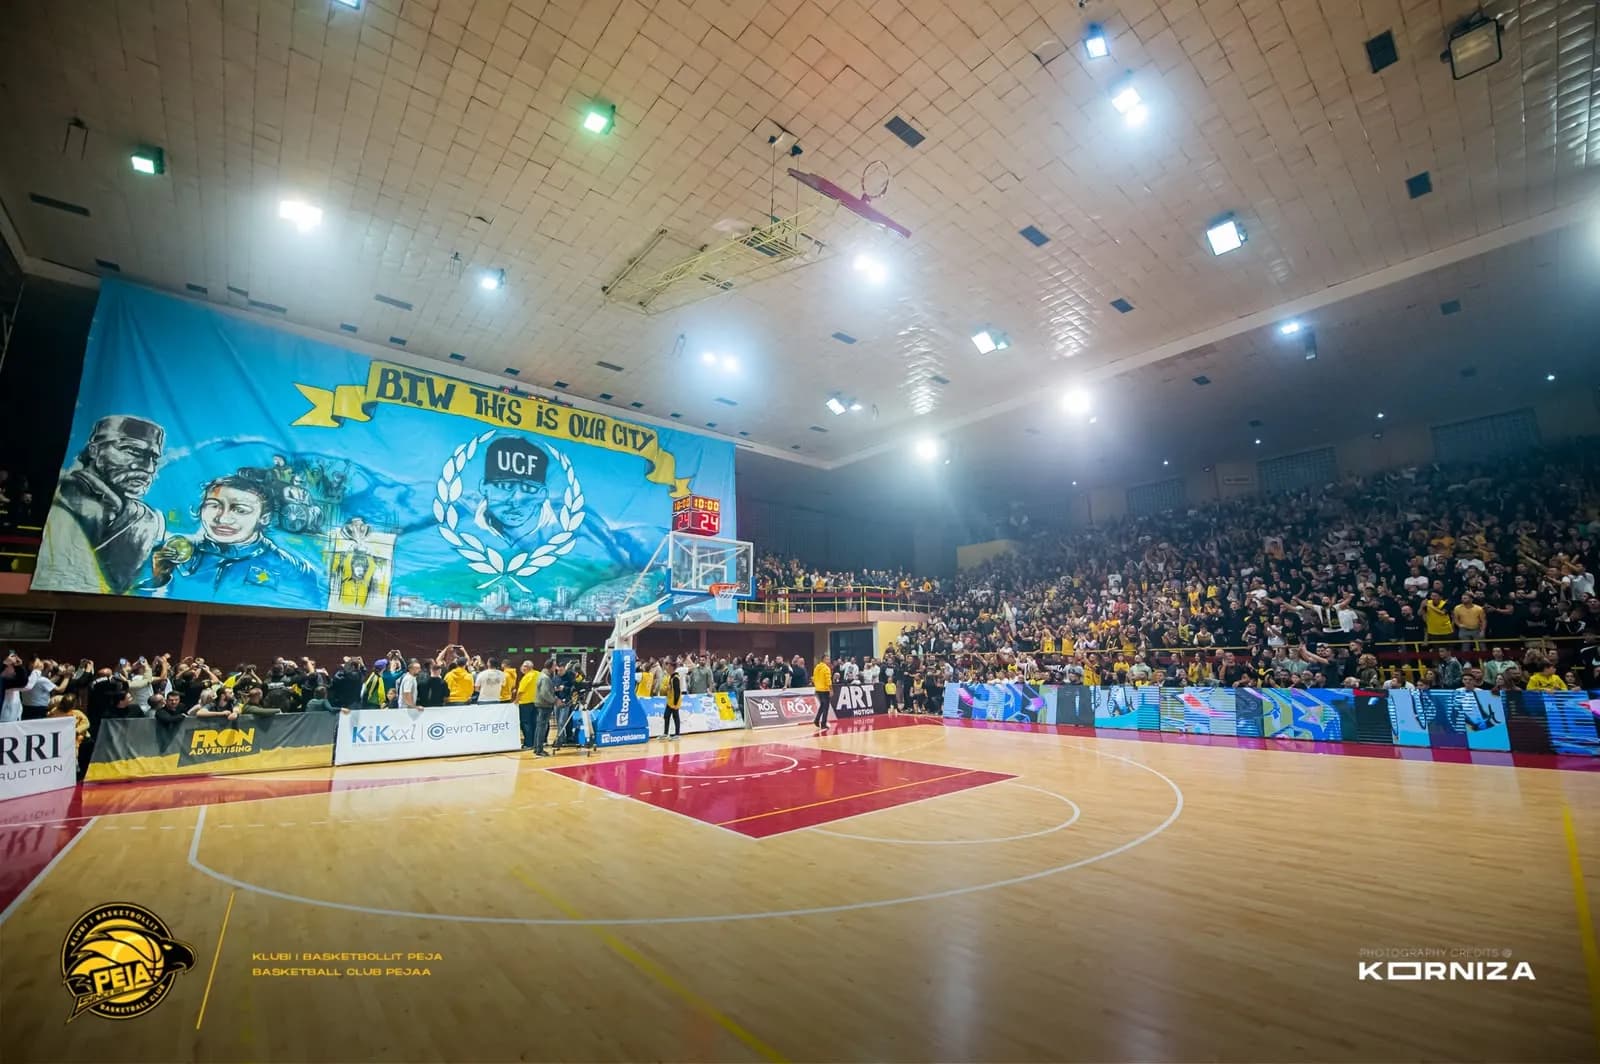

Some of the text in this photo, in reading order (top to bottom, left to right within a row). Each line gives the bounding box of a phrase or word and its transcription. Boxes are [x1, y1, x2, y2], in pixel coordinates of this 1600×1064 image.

[569, 413, 606, 442] OUR
[612, 423, 655, 452] CITY
[694, 498, 719, 511] 10:00
[700, 513, 719, 531] 24
[836, 684, 874, 710] ART
[853, 708, 874, 716] MOTION
[190, 727, 256, 748] FRON
[188, 745, 253, 756] ADVERTISING
